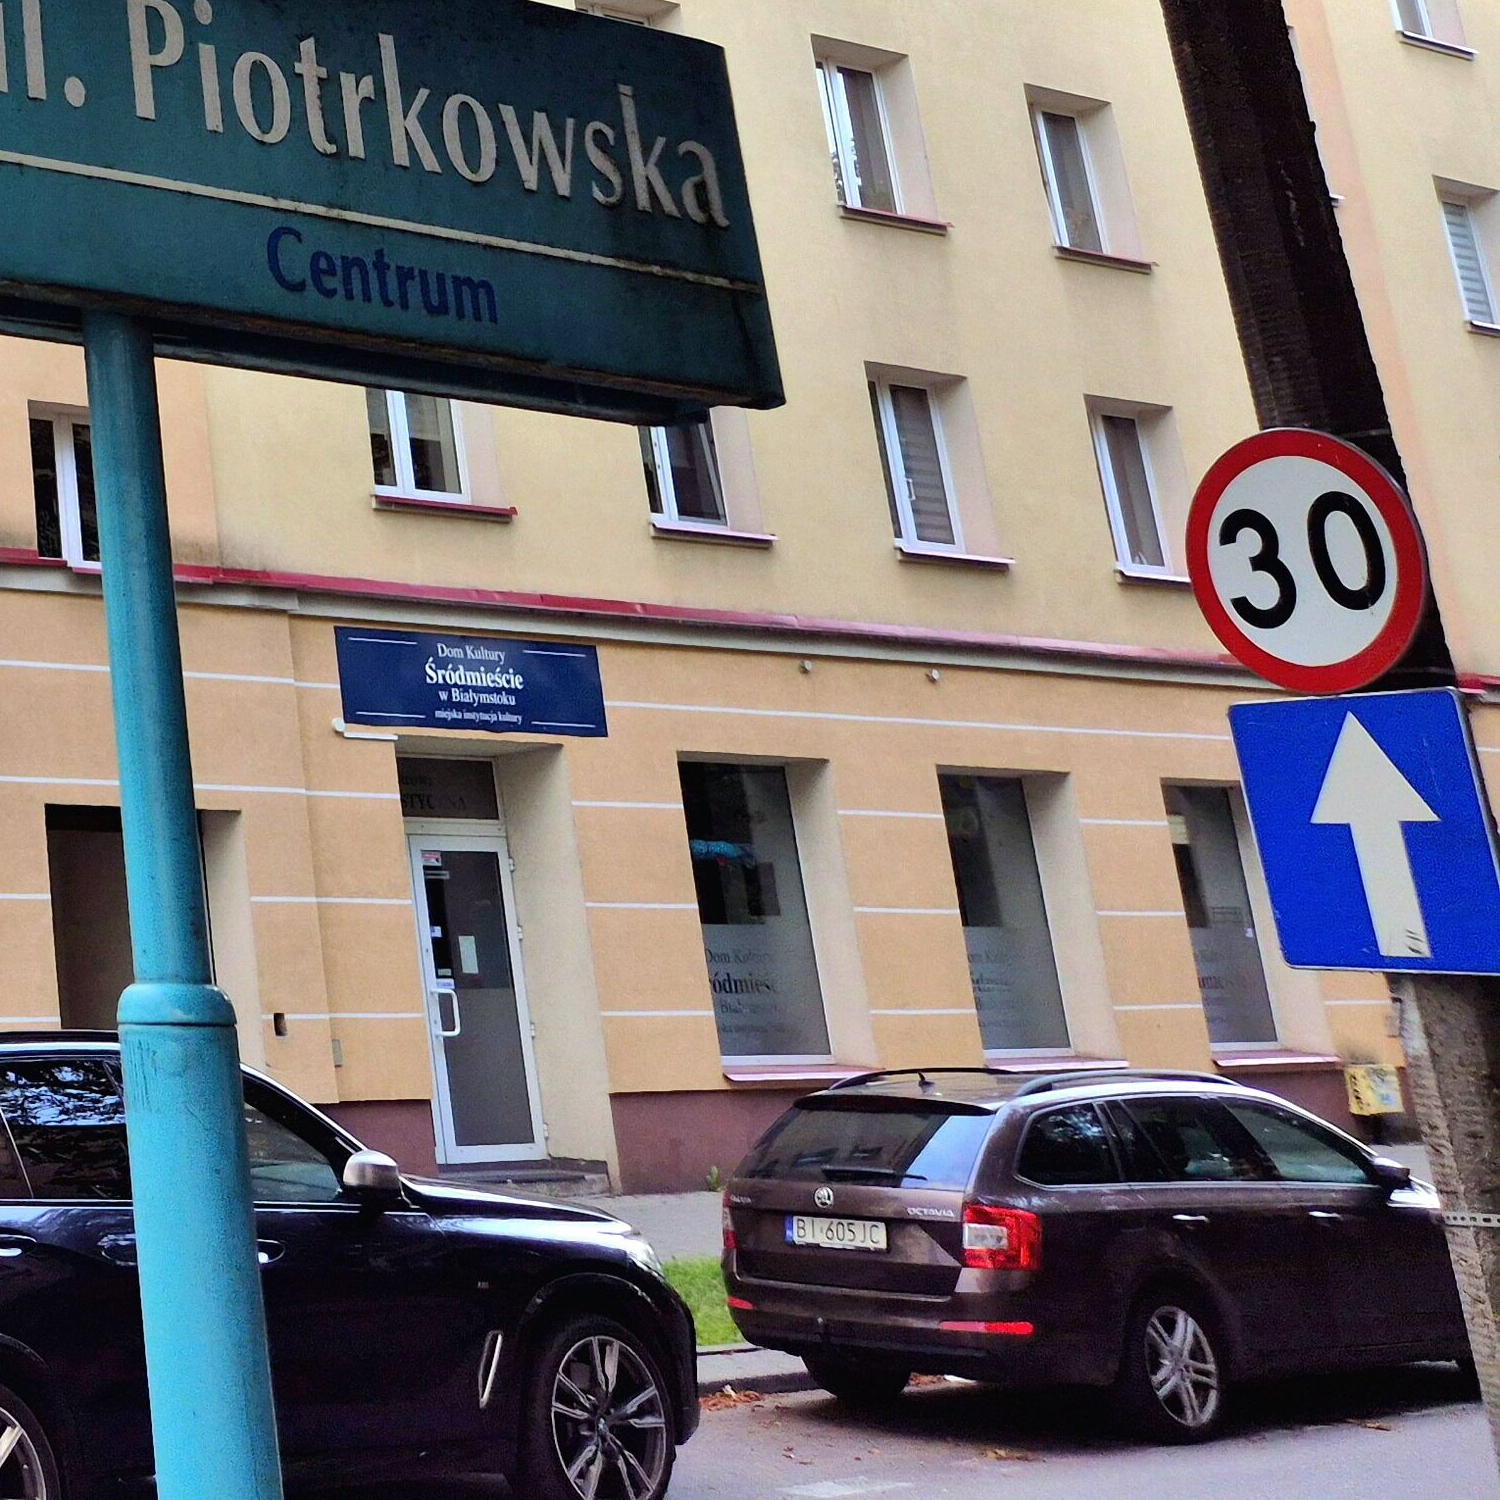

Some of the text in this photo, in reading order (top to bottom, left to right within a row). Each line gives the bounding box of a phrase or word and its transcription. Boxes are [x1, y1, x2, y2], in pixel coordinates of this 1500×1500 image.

[266, 227, 500, 324] Centrum
[1219, 490, 1386, 630] 30
[437, 643, 505, 665] Dom Kultury
[425, 656, 524, 690] Śródmieście
[438, 687, 516, 707] w Białymstoku
[435, 708, 462, 721] miejska
[498, 710, 522, 724] kultury
[906, 1207, 955, 1218] OCTAVIA
[796, 1218, 880, 1244] BI 605JC
